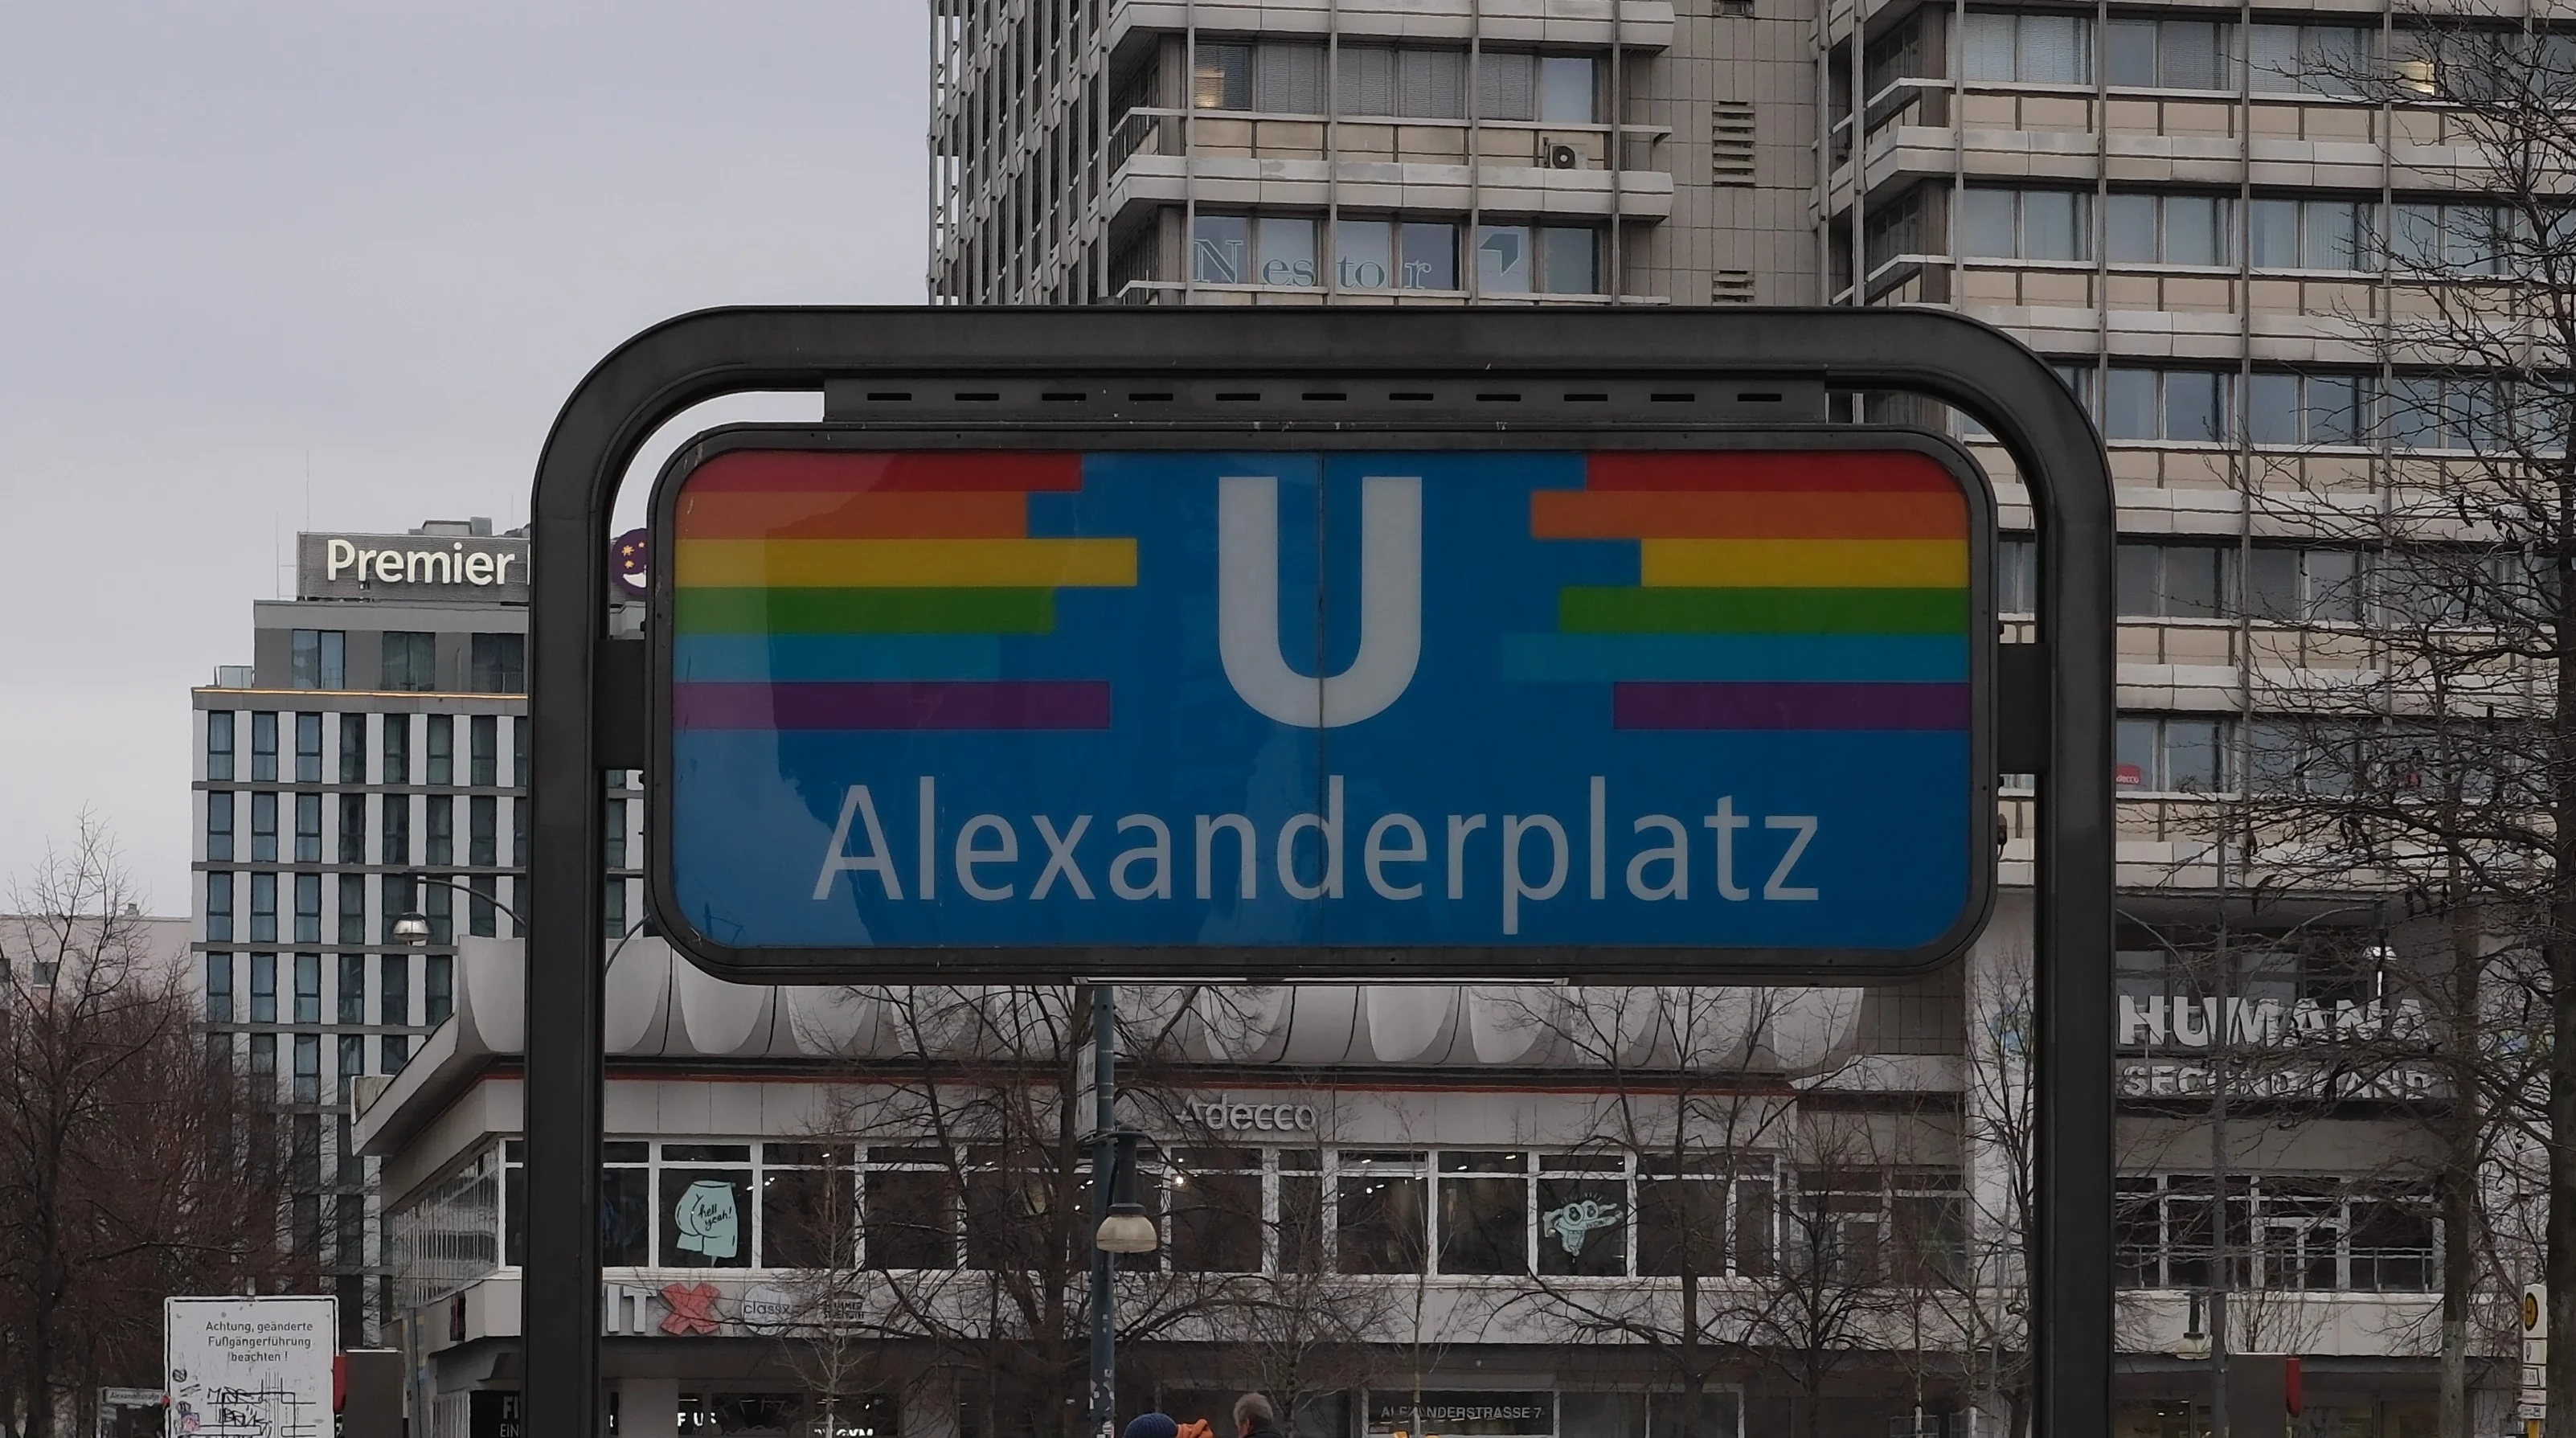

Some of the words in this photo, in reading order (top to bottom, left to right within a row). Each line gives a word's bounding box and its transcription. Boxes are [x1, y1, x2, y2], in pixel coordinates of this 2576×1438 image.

[327, 539, 515, 585] Premier
[1218, 476, 1423, 728] U
[812, 775, 1819, 935] Alexanderplatz
[2119, 994, 2431, 1047] HUMANA
[1176, 1093, 1317, 1131] Adecco
[698, 1203, 718, 1219] hell
[705, 1206, 732, 1231] yeah!
[206, 1321, 254, 1334] Achtung,
[257, 1321, 313, 1334] geänderte
[208, 1336, 311, 1350] Fußgängerführung
[231, 1351, 281, 1362] beachten
